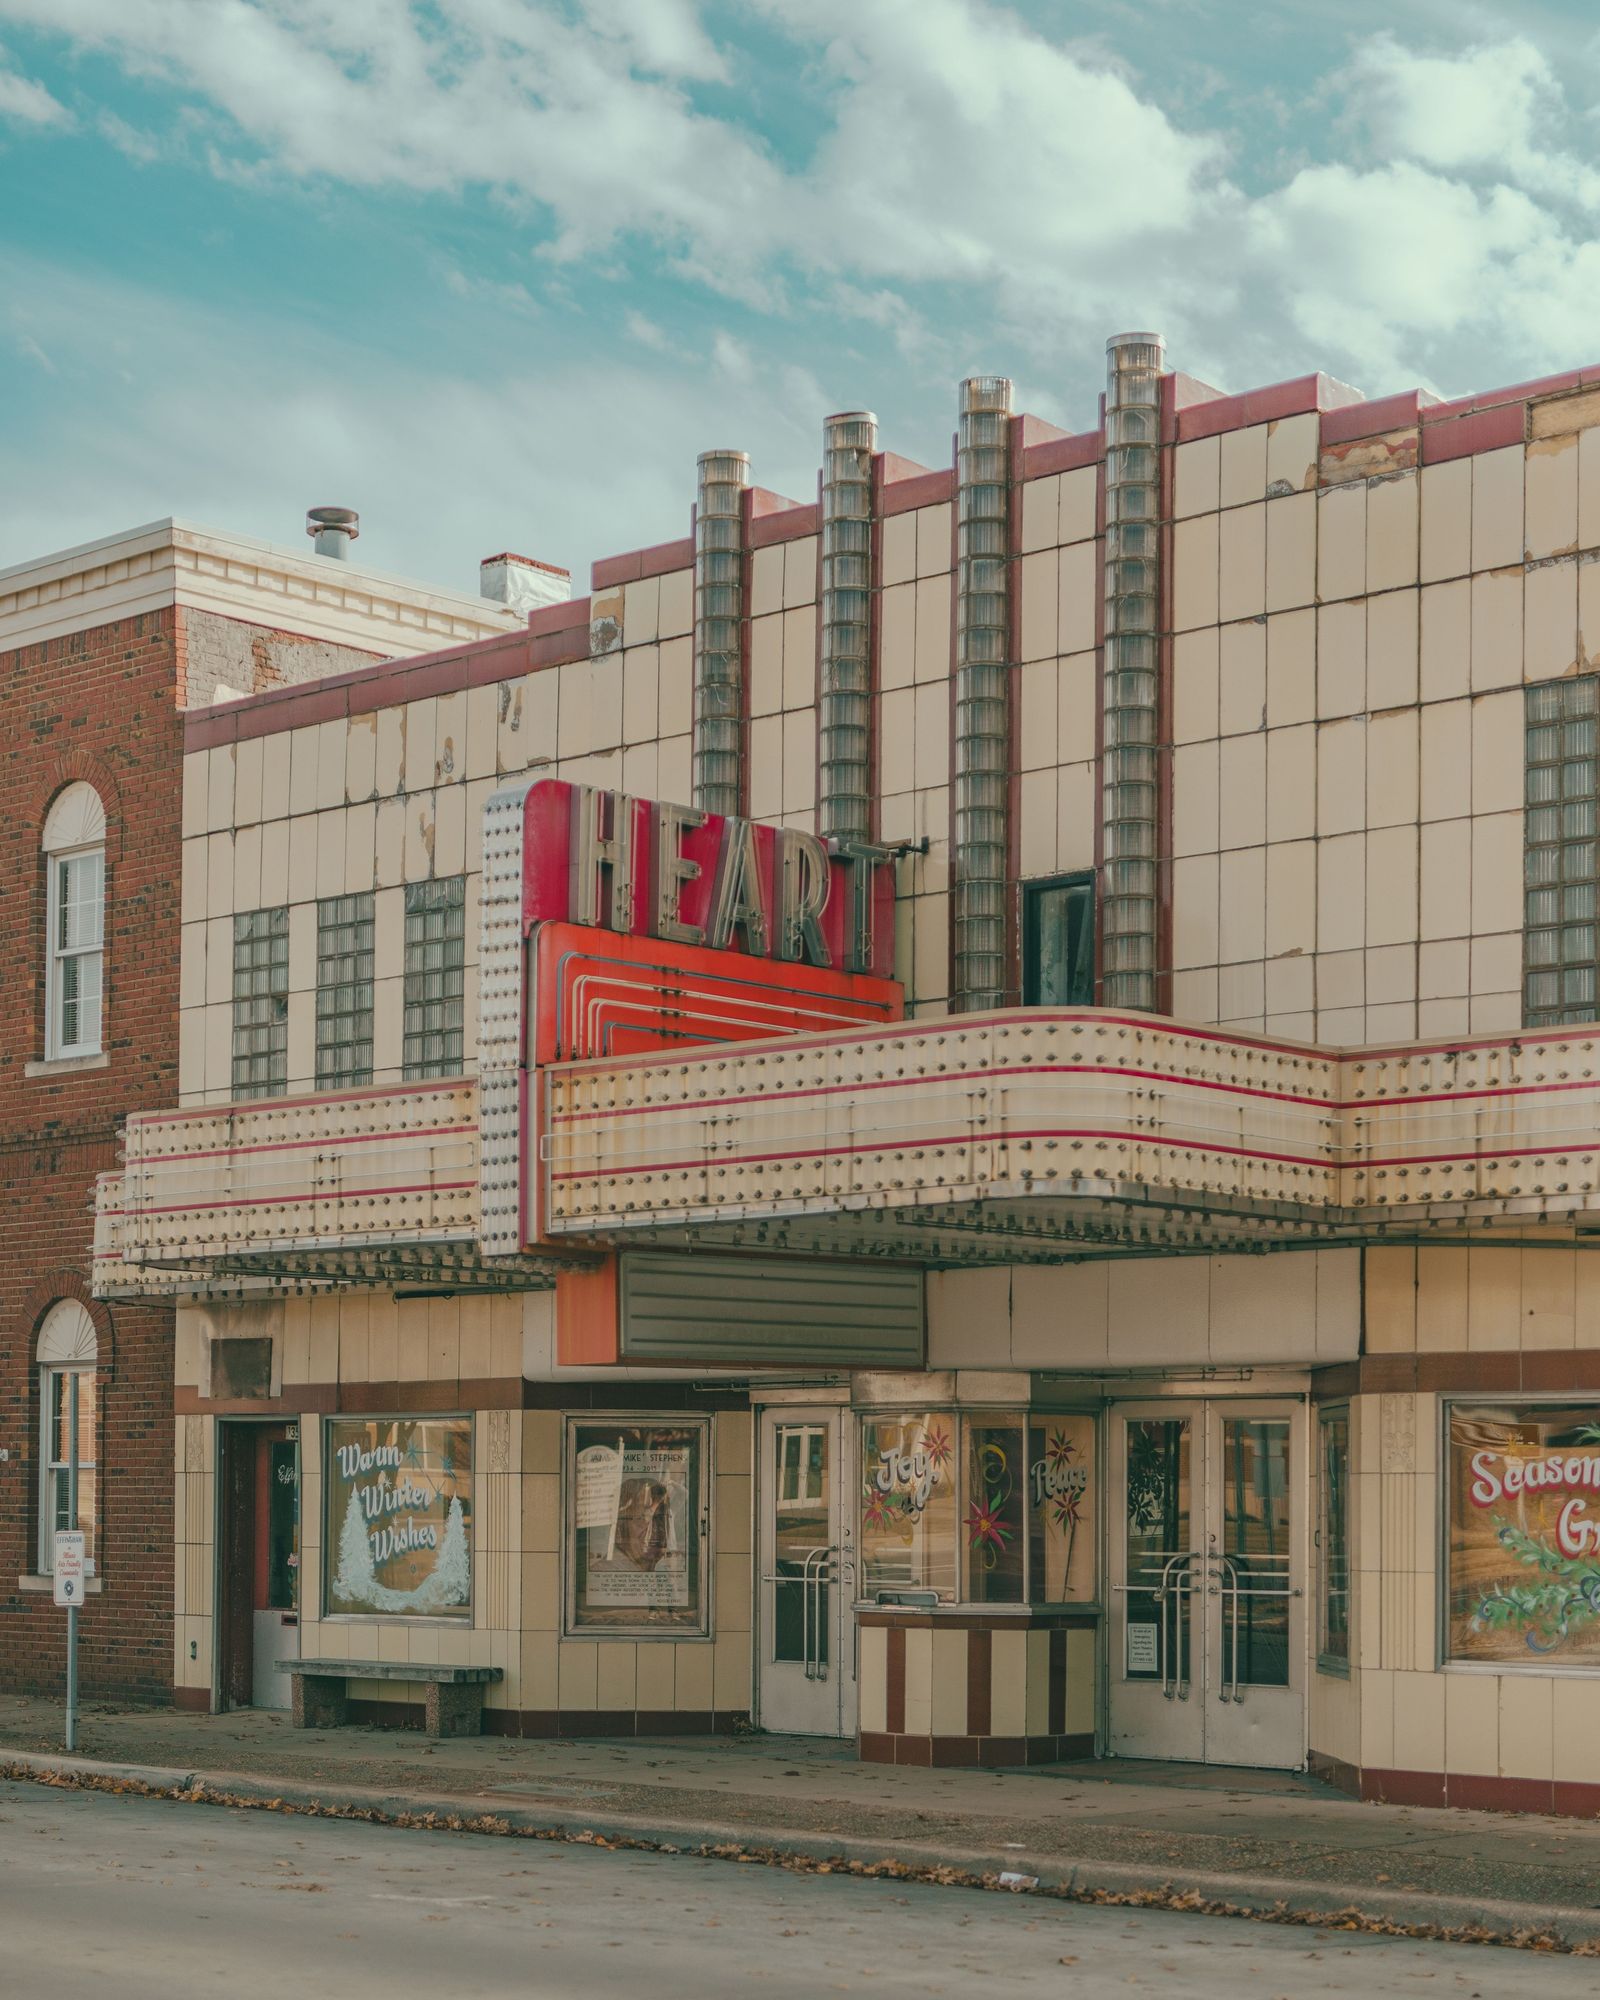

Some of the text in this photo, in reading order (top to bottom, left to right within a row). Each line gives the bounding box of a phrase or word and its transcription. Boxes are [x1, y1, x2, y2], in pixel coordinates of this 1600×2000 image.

[570, 783, 893, 973] HEART
[337, 1443, 404, 1479] Warm
[877, 1448, 939, 1511] Joy
[1030, 1459, 1087, 1505] Peace
[361, 1475, 431, 1519] Winter
[371, 1516, 437, 1562] Wishes
